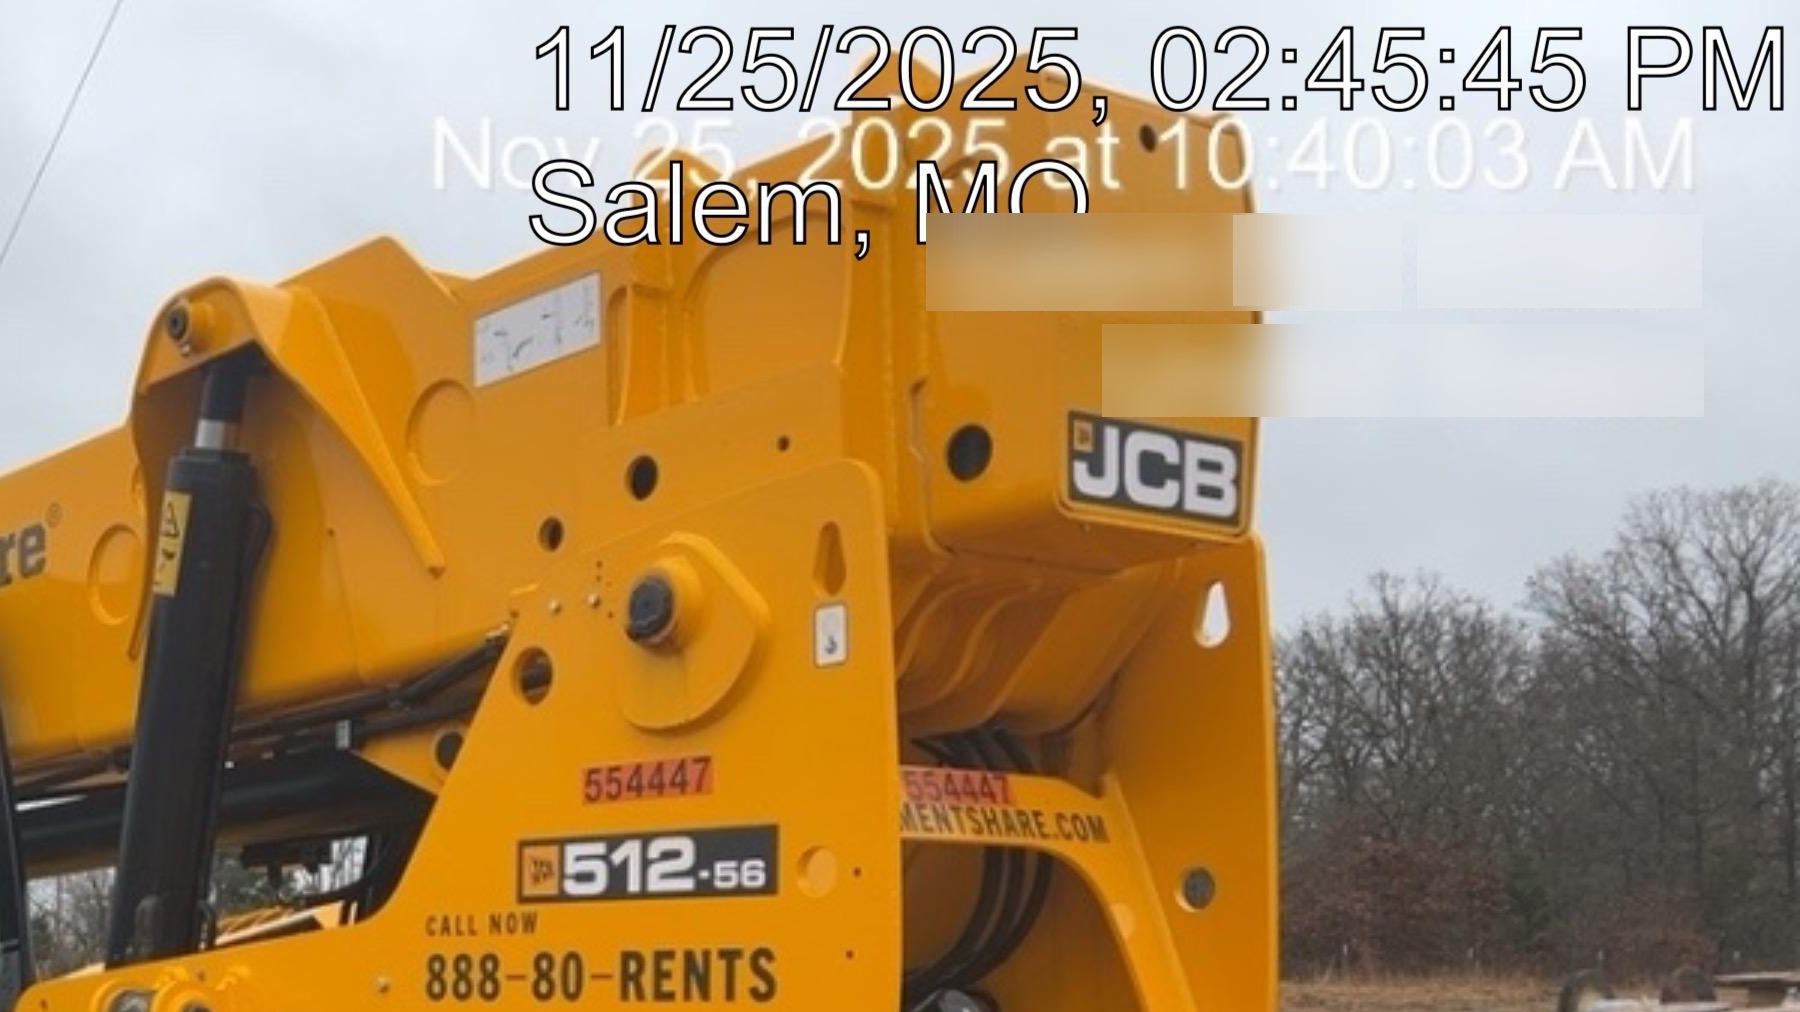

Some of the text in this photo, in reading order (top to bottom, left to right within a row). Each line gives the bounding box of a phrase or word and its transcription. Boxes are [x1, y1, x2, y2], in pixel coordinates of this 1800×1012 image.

[1073, 425, 1237, 518] JCB
[584, 755, 712, 803] 554447
[904, 769, 1010, 805] 554447
[562, 836, 767, 895] 512-56
[425, 912, 538, 937] CALL NOW
[425, 947, 777, 1002] 888-80-RENTS
